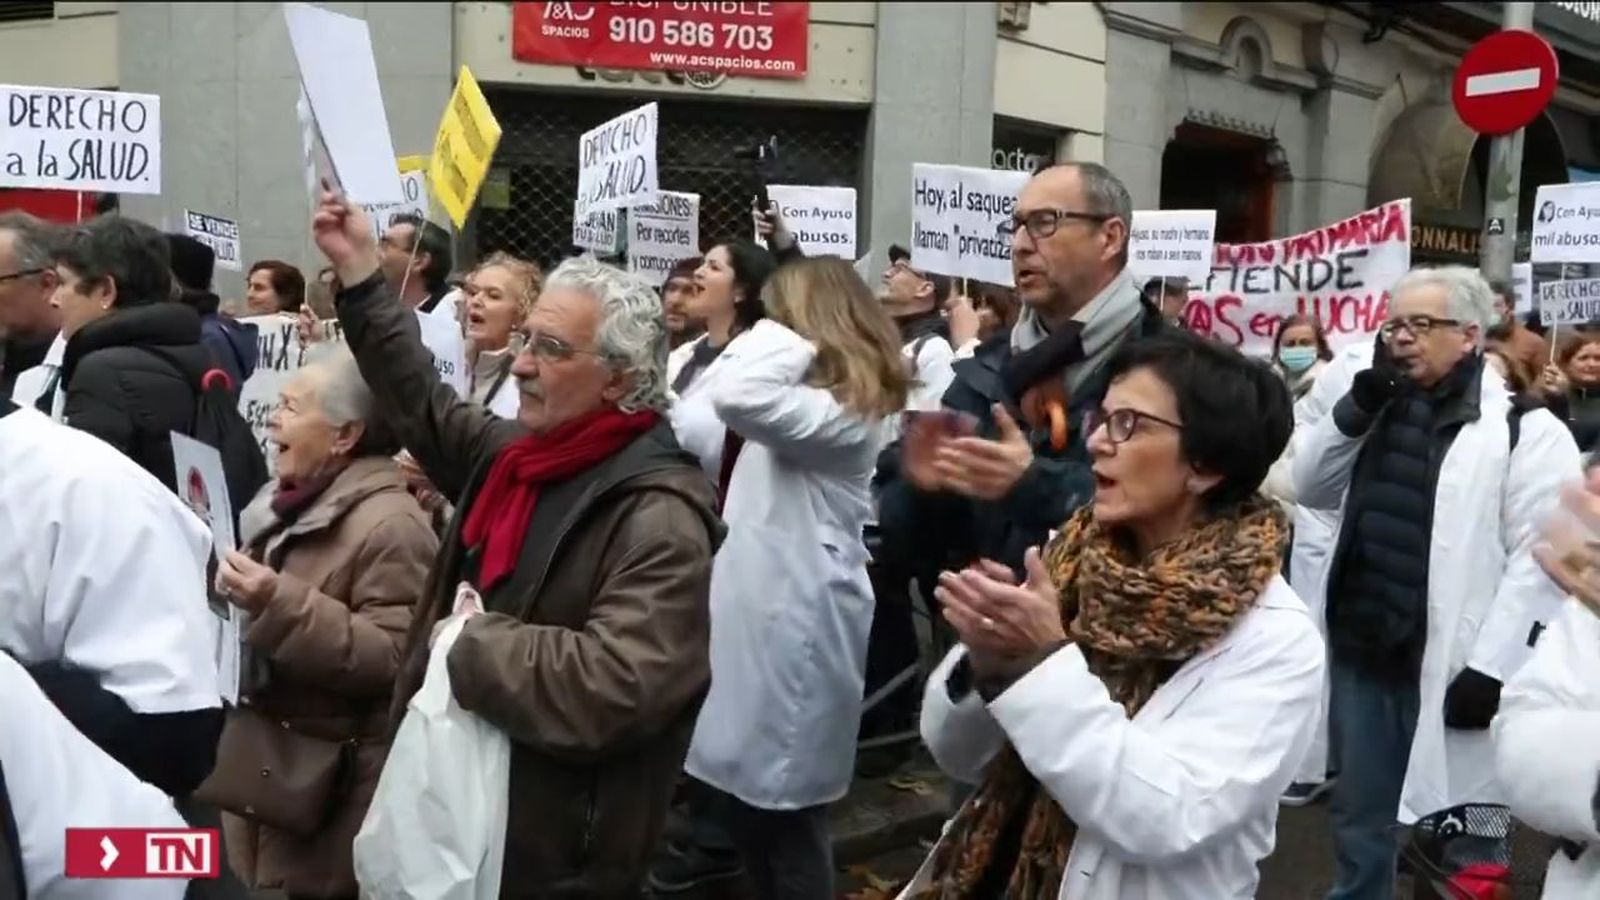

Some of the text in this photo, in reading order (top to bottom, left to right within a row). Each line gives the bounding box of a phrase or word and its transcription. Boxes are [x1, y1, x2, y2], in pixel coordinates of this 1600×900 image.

[541, 25, 590, 38] SPACIOS
[609, 16, 774, 51] 910 586 703
[650, 51, 796, 71] www.acspacios.com
[9, 93, 147, 133] DERECHO
[6, 138, 149, 182] a la SALUD.
[914, 177, 948, 215] Hoy,
[950, 182, 963, 209] al
[782, 206, 853, 221] Con Ayuso
[1557, 206, 1575, 219] Con
[636, 222, 653, 241] Por
[913, 221, 949, 251] llaman
[1535, 231, 1600, 247] mil abuso
